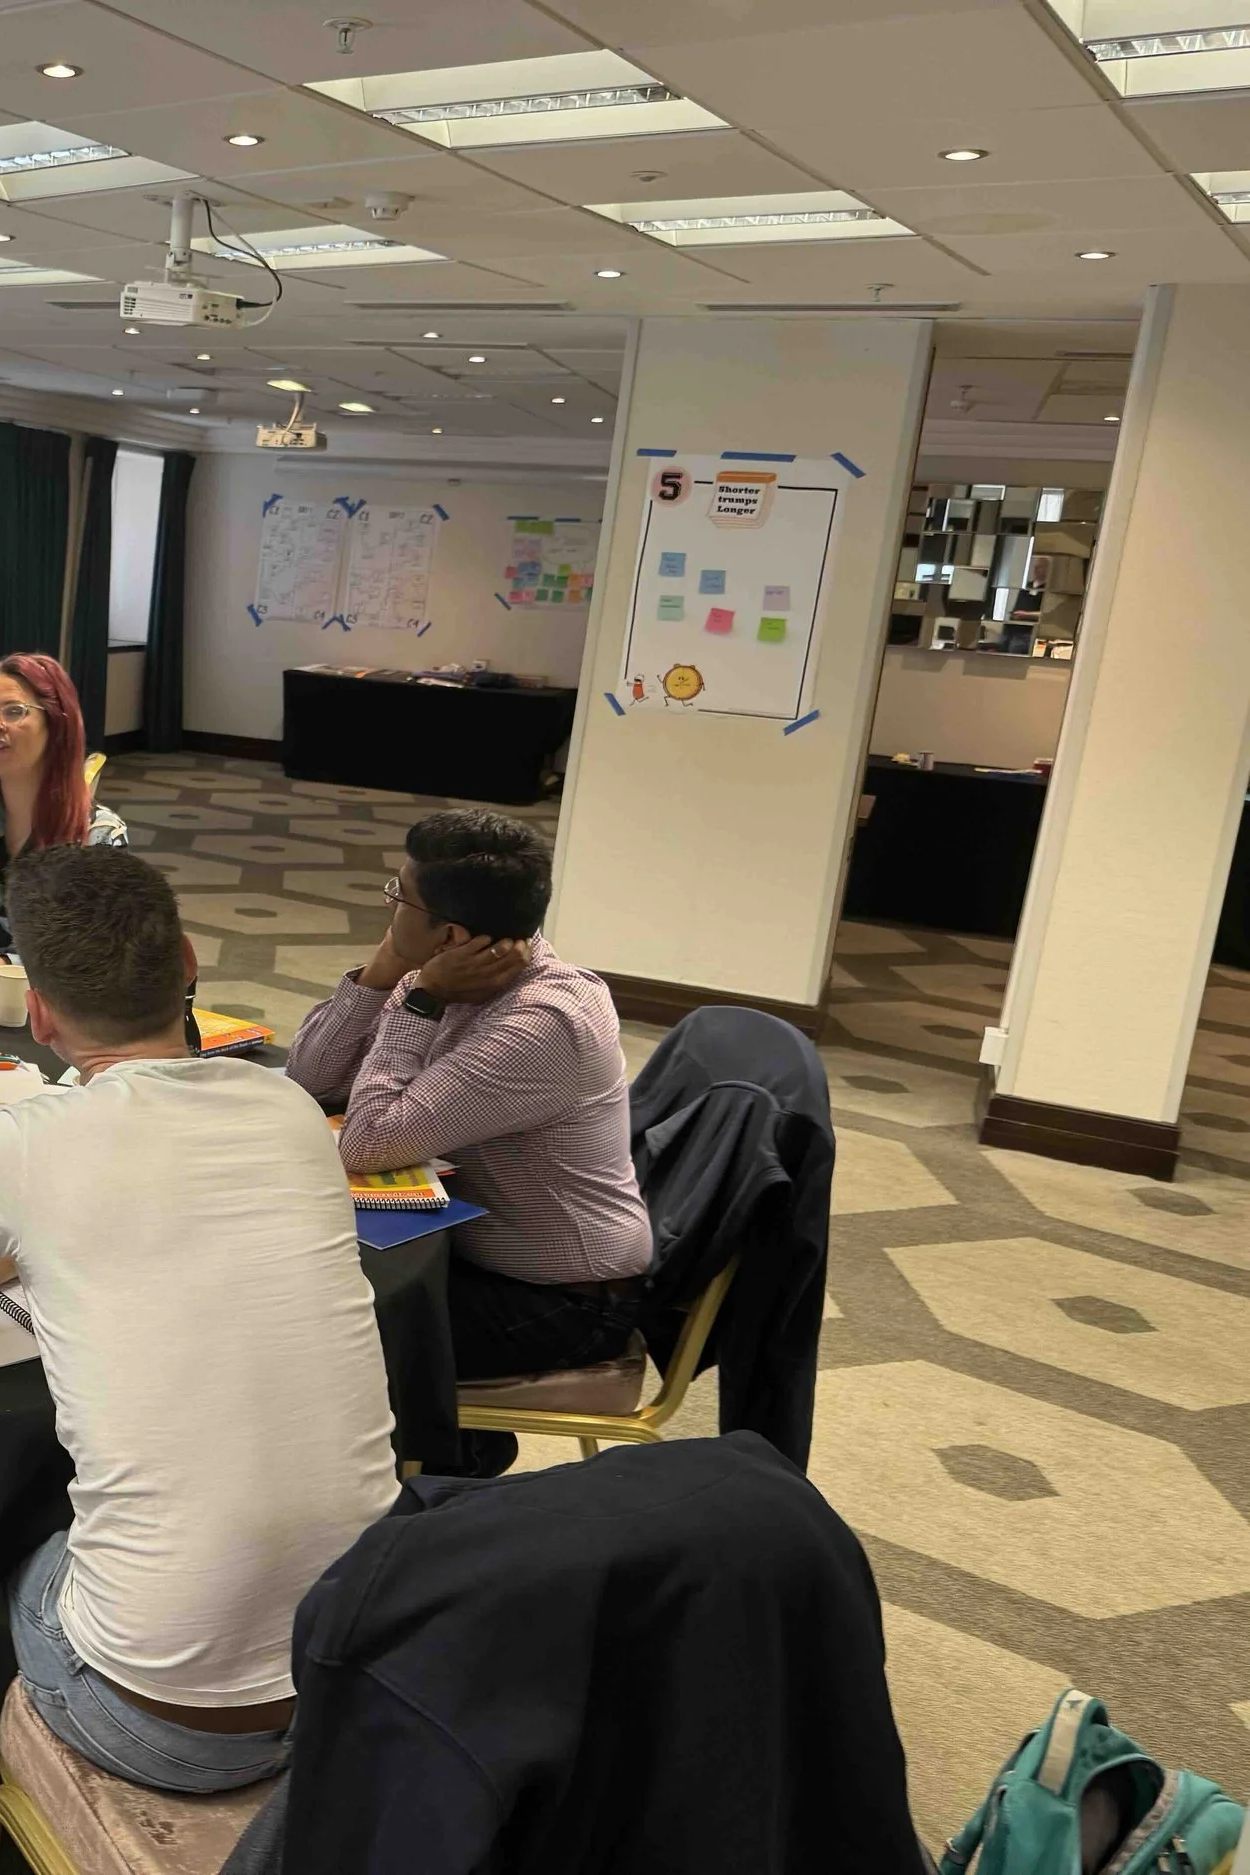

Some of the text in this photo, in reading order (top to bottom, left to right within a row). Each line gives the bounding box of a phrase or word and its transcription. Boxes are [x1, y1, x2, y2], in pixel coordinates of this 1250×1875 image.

[658, 472, 683, 501] 5
[718, 485, 761, 495] Shorter
[718, 495, 758, 506] trumps
[717, 505, 756, 515] Longer
